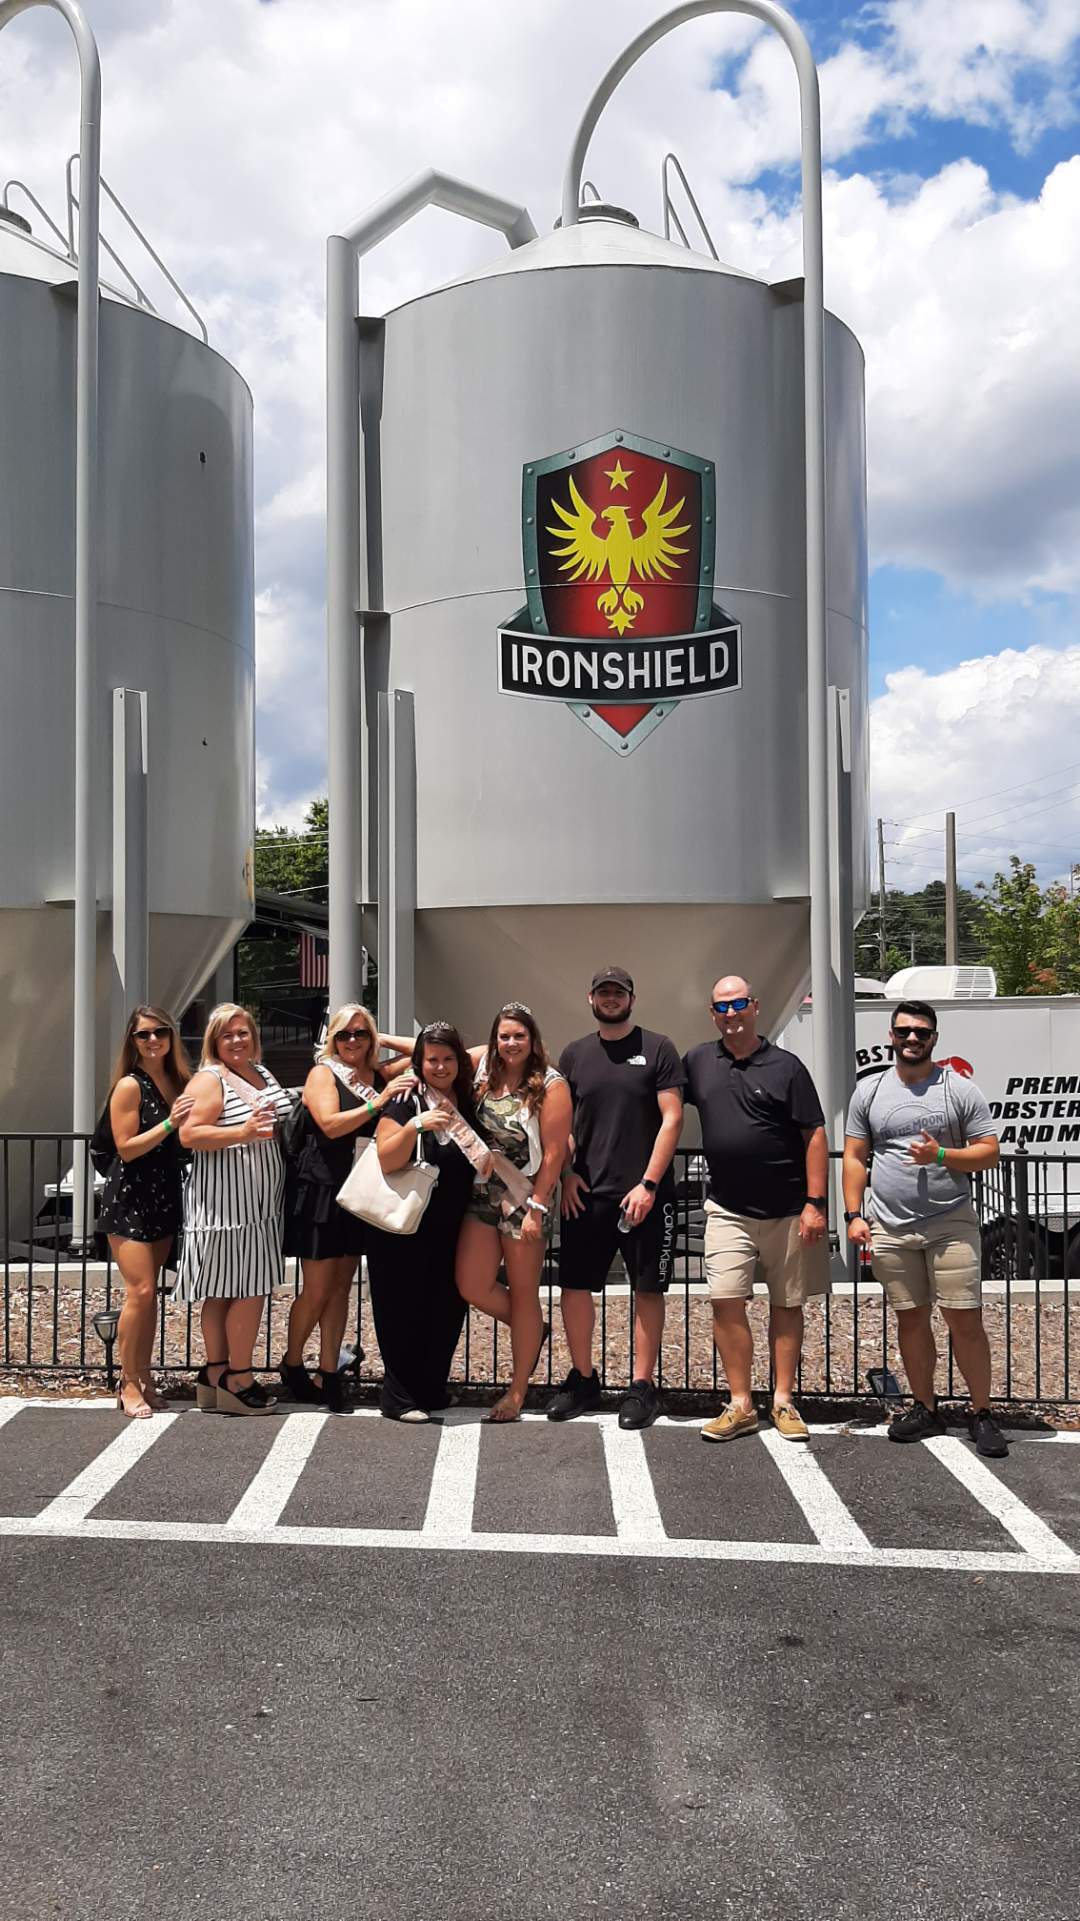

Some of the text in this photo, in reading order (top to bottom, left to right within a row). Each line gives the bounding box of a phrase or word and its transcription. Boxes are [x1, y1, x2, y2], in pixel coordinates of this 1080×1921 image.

[511, 641, 729, 690] IRONSHIELD
[913, 1114, 944, 1133] MOON
[1000, 1125, 1054, 1143] AND
[659, 1203, 675, 1282] Calvin Klein
